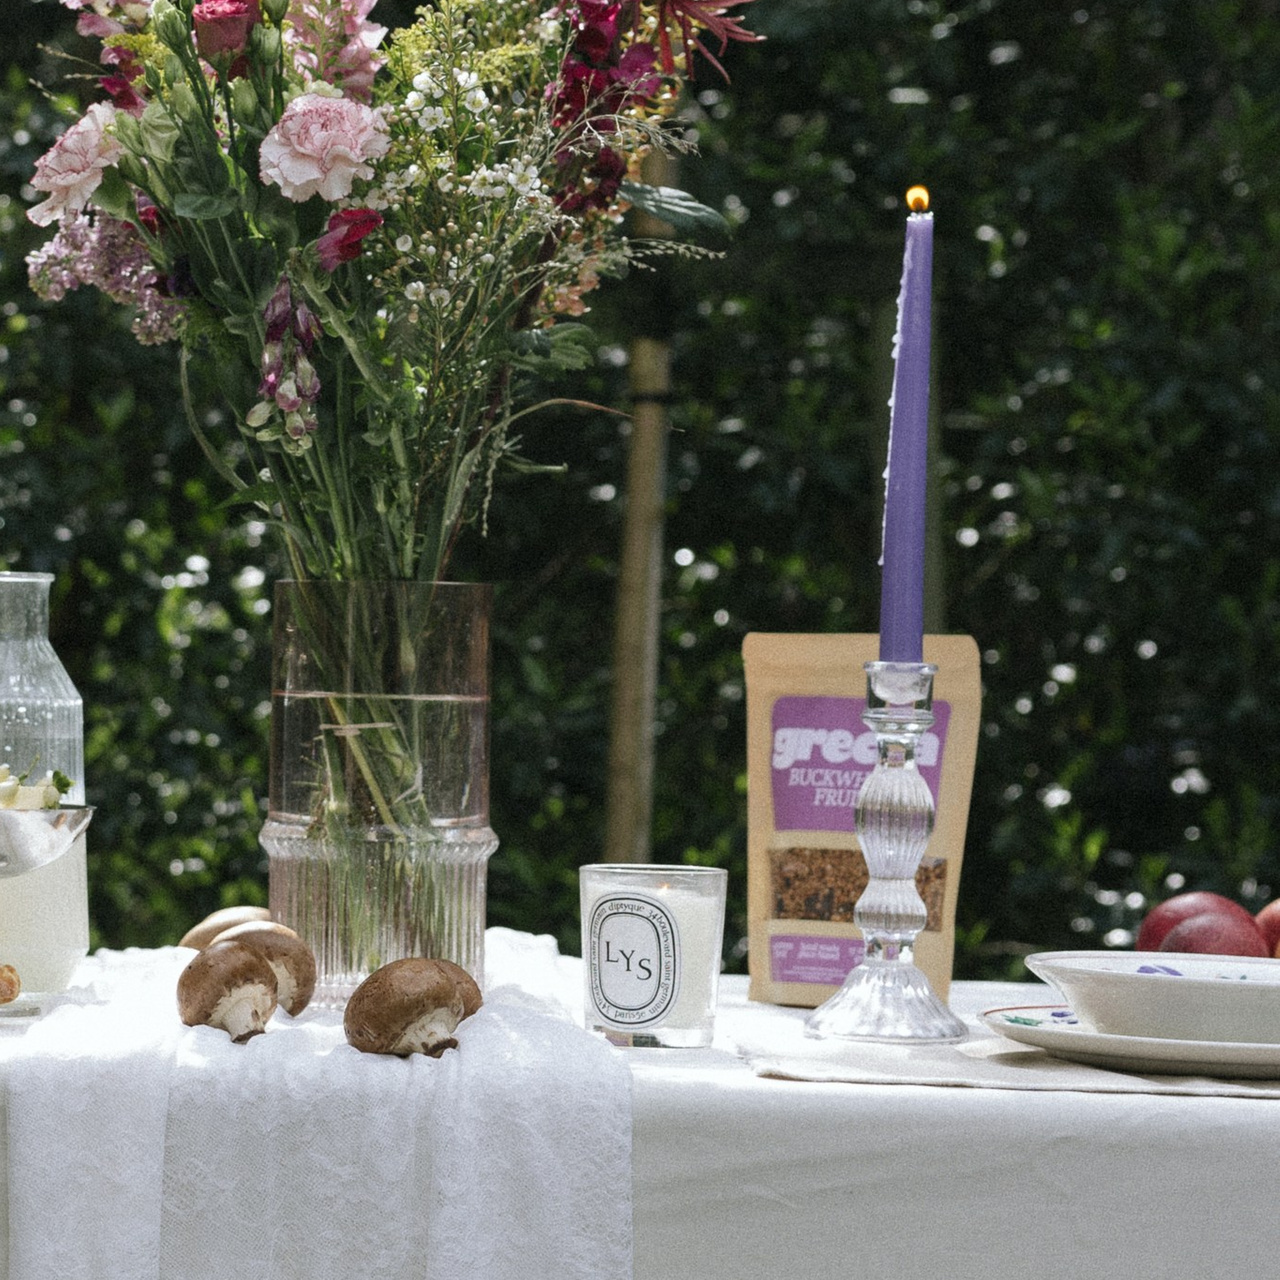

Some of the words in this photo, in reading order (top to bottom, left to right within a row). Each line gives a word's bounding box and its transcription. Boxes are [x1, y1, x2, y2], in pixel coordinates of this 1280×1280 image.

[772, 727, 940, 770] greca
[608, 902, 645, 913] diptyque
[648, 910, 658, 921] 34
[657, 915, 673, 959] boulevard
[605, 941, 652, 981] LYS
[664, 960, 673, 981] saint
[649, 982, 670, 1015] germain
